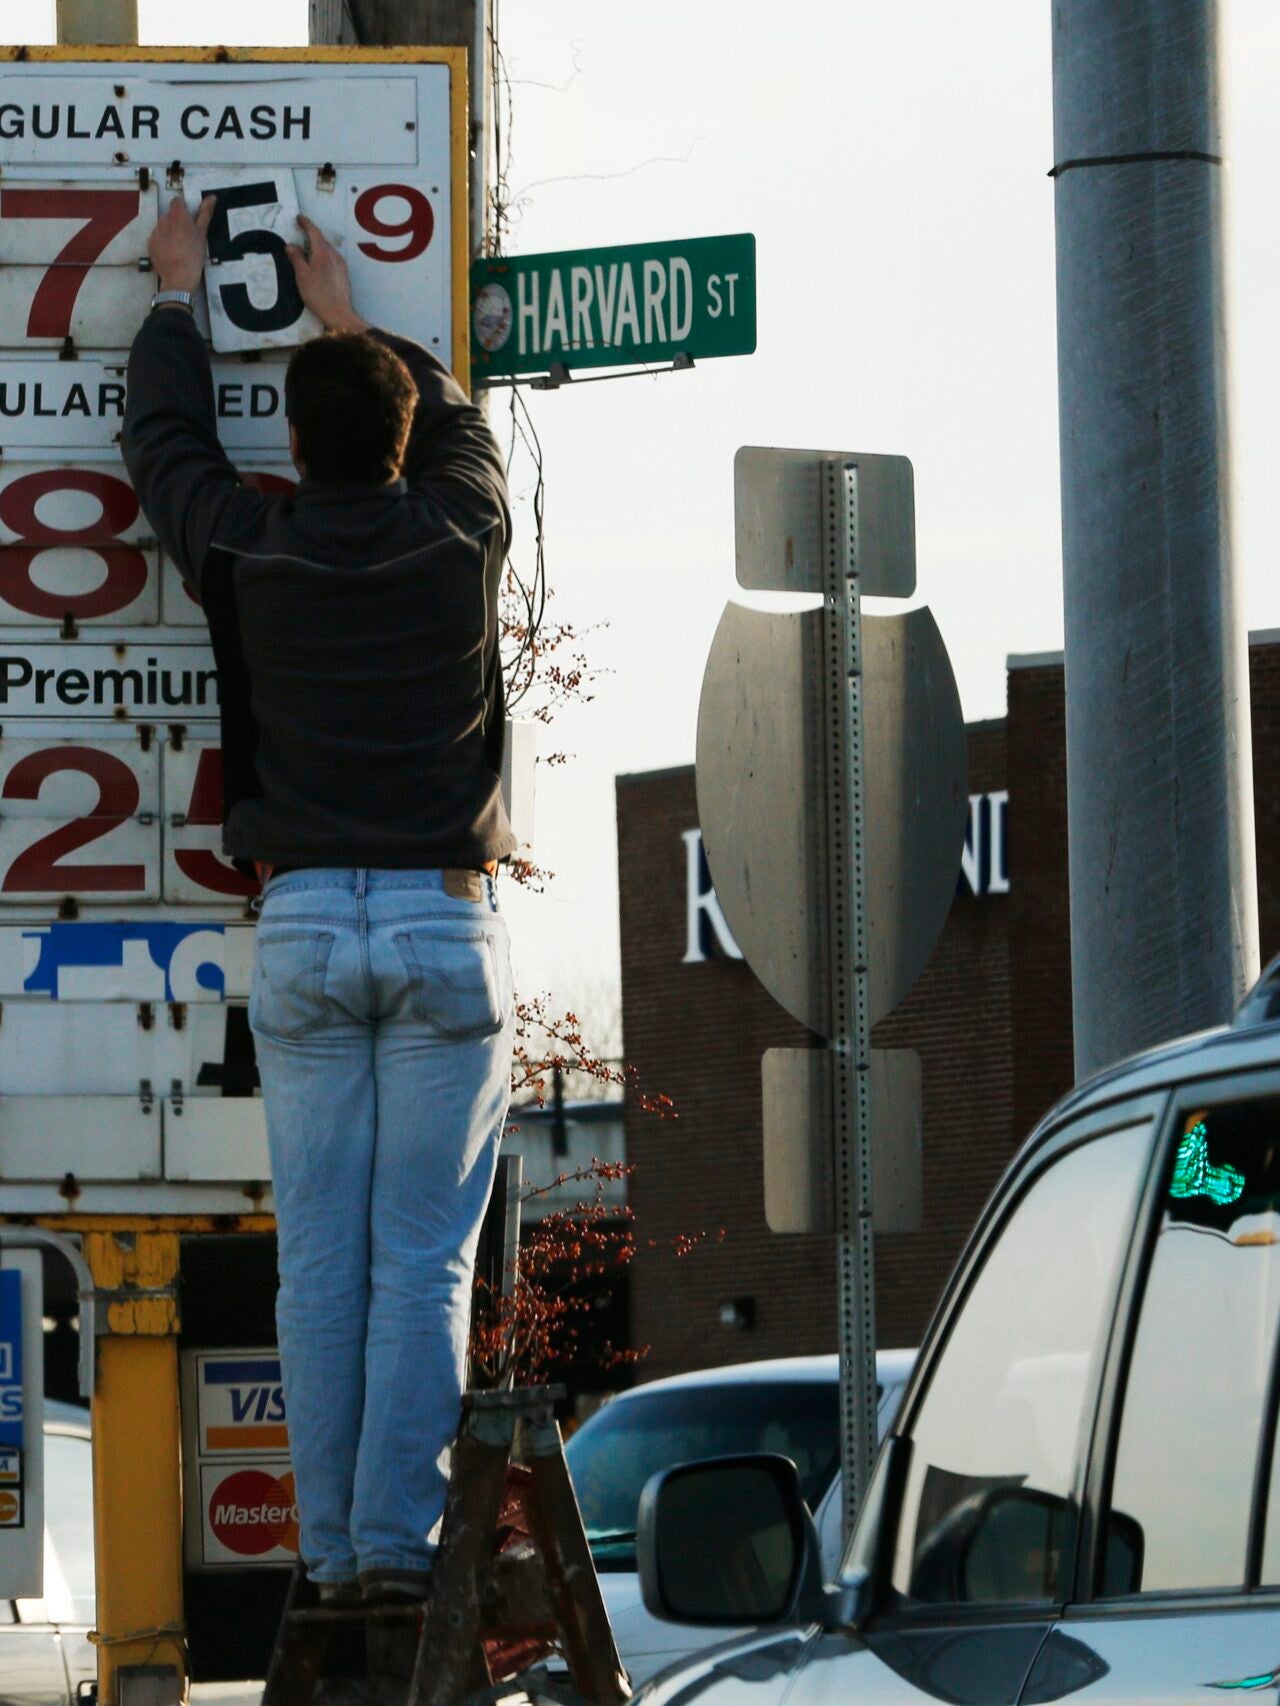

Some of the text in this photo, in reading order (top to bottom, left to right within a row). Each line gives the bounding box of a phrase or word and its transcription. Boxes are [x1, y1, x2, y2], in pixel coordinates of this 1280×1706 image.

[180, 104, 312, 140] CASH
[354, 183, 435, 264] 9
[517, 256, 739, 355] HARVARD ST
[229, 1387, 286, 1422] VIS
[214, 1503, 299, 1525] Master
